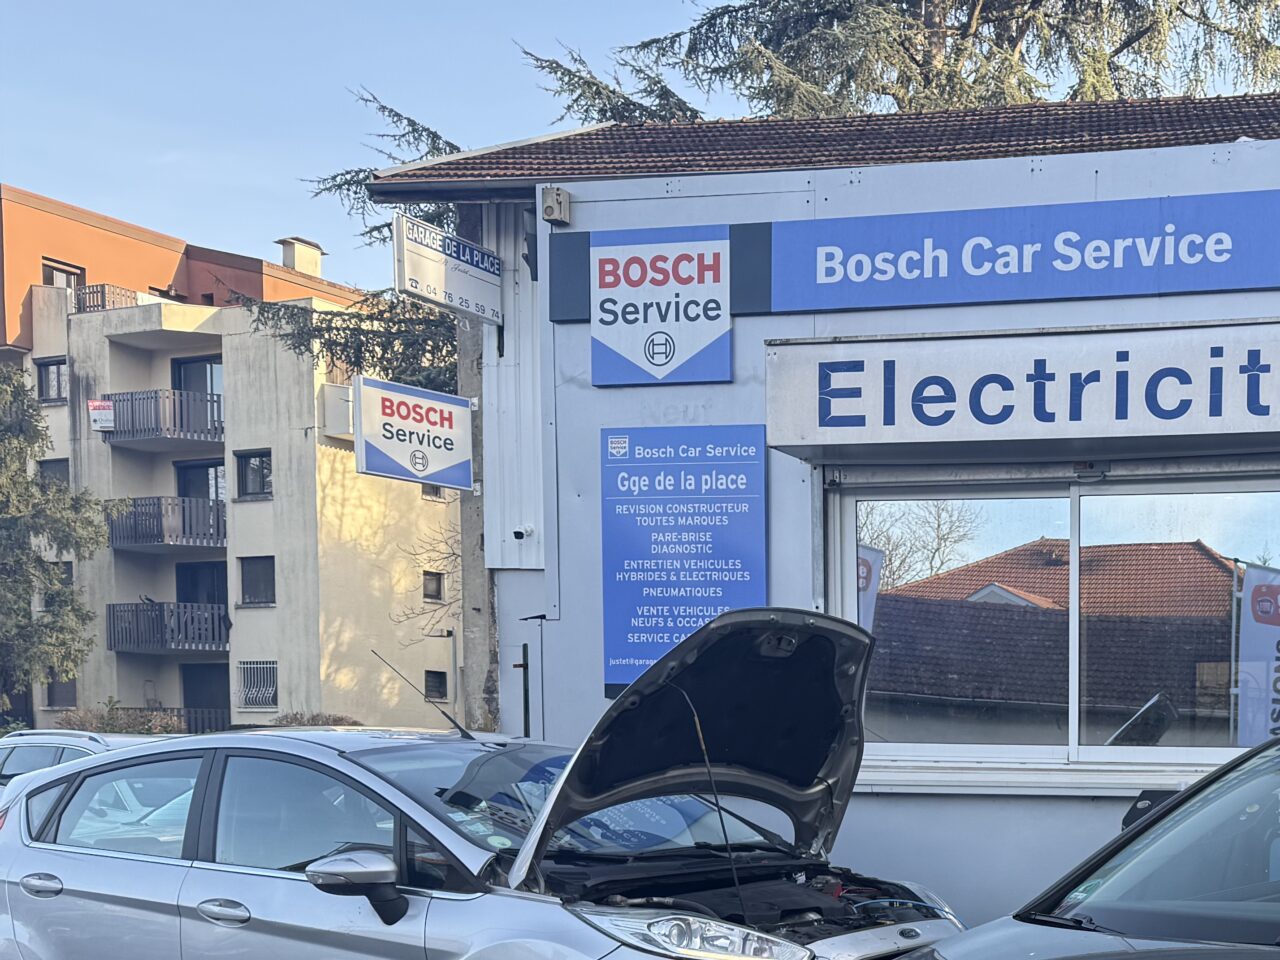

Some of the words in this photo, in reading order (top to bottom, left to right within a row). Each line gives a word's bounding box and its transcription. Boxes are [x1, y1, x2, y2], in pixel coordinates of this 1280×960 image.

[406, 221, 443, 252] GARAGE
[445, 238, 457, 257] DE
[460, 244, 471, 262] LA
[473, 249, 500, 274] PLACE
[816, 238, 948, 284] Bosch
[961, 236, 1041, 277] Car
[1052, 223, 1233, 272] Service
[598, 252, 721, 289] BOSCH
[426, 284, 437, 296] 04
[443, 290, 453, 303] 76
[458, 296, 470, 309] 25
[475, 303, 485, 315] 59
[490, 308, 500, 319] 74
[598, 292, 722, 326] Service
[380, 396, 454, 430] BOSCH
[381, 422, 455, 452] Service
[635, 446, 674, 458] Bosch
[679, 445, 701, 457] Car
[706, 443, 756, 457] Service
[617, 471, 649, 495] Gge
[655, 471, 674, 491] de
[680, 470, 695, 490] la
[701, 470, 747, 494] place
[616, 504, 663, 514] REVISION
[666, 503, 749, 514] CONSTRUCTEUR
[636, 516, 675, 526] TOUTES
[678, 516, 729, 526] MARQUES
[651, 532, 712, 542] PARE-BRISE
[651, 544, 712, 554] DIAGNOSTIC
[624, 560, 681, 570] ENTRETIEN
[683, 559, 742, 569] VEHICULES
[616, 571, 667, 581] HYBRIDES
[669, 572, 677, 581] &
[680, 571, 750, 581] ELECTRIQUES
[643, 587, 723, 597] PNEUMATIQUES
[636, 606, 670, 616] VENTE
[631, 618, 665, 627] NEUFS
[667, 617, 674, 627] &
[676, 617, 713, 627] OCCAS
[627, 633, 670, 643] SERVICE
